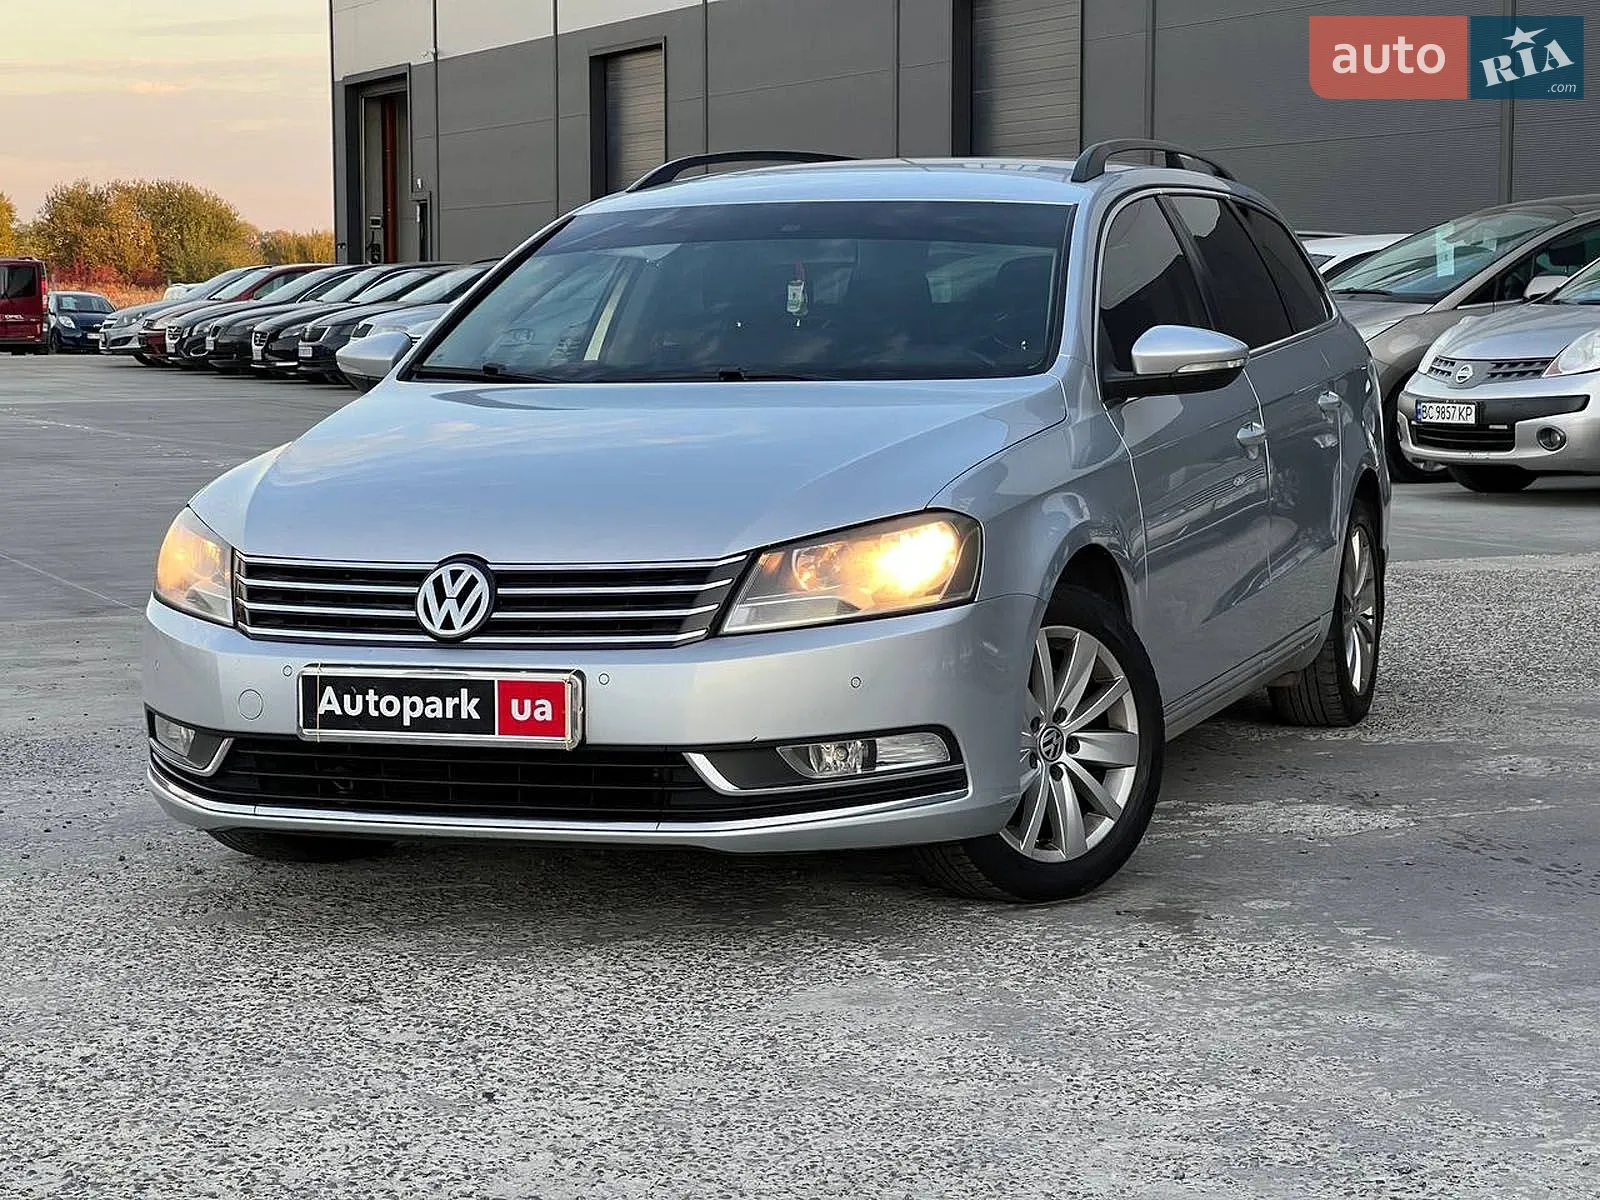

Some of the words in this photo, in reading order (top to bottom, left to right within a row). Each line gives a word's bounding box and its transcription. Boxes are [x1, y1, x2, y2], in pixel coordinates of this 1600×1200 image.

[1422, 405, 1434, 420] BC
[1436, 405, 1457, 420] 9857
[1458, 406, 1473, 421] KP
[318, 686, 481, 726] Autopark
[511, 698, 553, 721] ua
